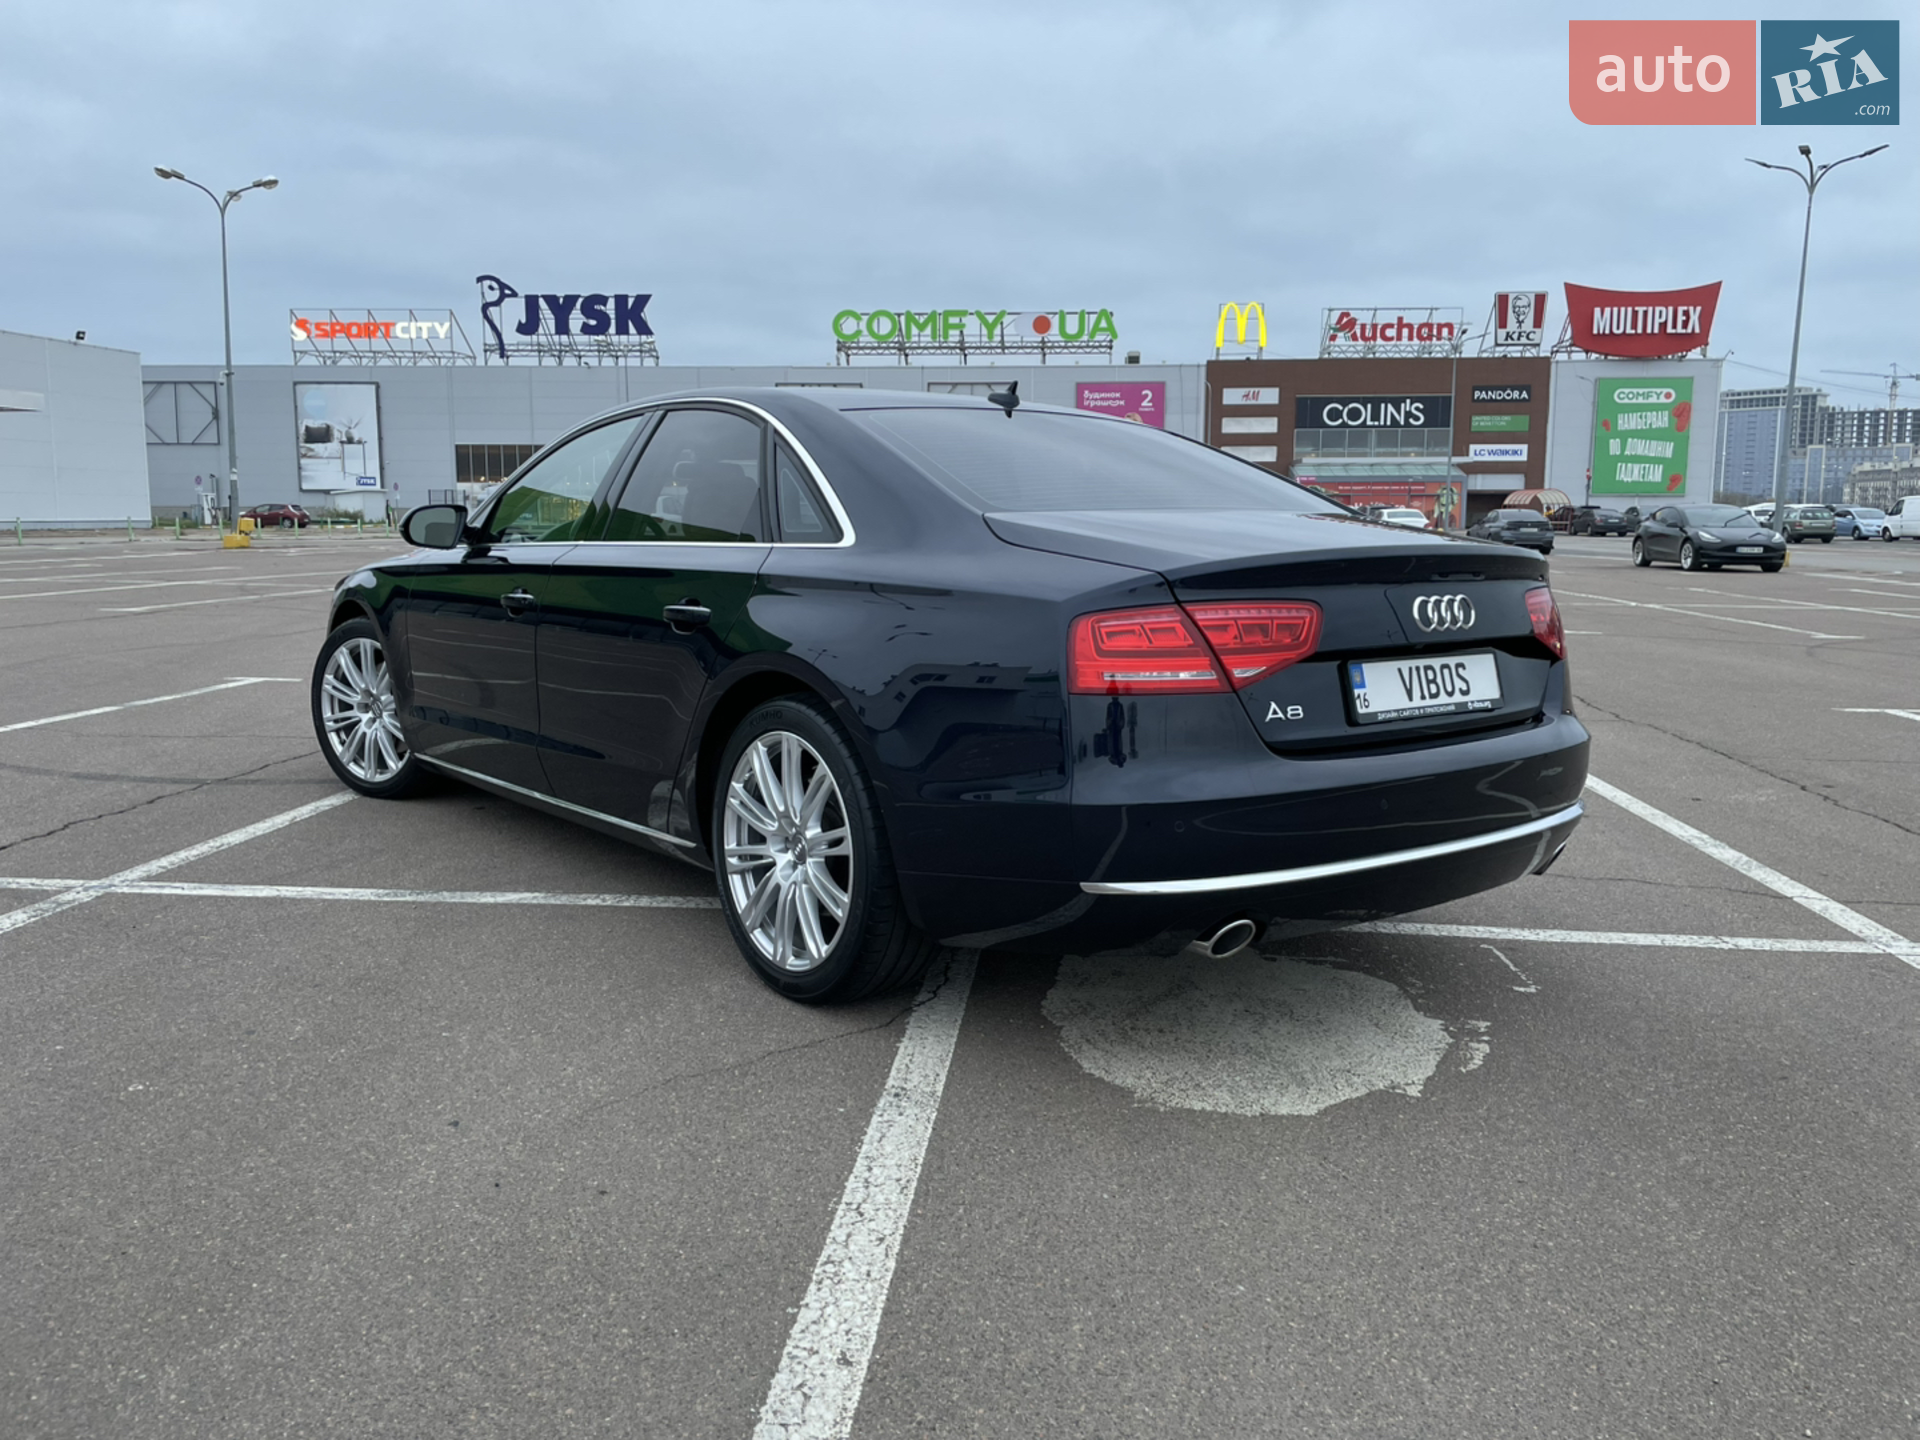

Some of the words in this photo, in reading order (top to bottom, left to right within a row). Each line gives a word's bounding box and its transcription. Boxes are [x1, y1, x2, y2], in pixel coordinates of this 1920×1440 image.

[515, 294, 654, 336] JYSK
[1592, 305, 1702, 335] MULTIPLEX
[314, 321, 450, 340] SPORTCITY
[832, 309, 1008, 342] COMFY
[1058, 308, 1119, 341] UA
[1328, 311, 1454, 343] Auchan
[1503, 330, 1536, 342] KFC
[1140, 389, 1153, 407] 2
[1474, 388, 1529, 400] PANDORA
[1617, 391, 1664, 400] COMFY
[1322, 399, 1425, 426] COLIN'S
[1617, 411, 1669, 430] НАМБЕРВАН
[1474, 449, 1485, 457] LC
[1609, 438, 1621, 455] ПО
[1624, 438, 1674, 458] ДОМАШНІМ
[1616, 462, 1664, 482] ГАДЖЕТАМ
[1397, 661, 1471, 702] VIBOS
[1356, 692, 1370, 709] 16
[750, 710, 783, 728] KUMHO
[1265, 700, 1304, 722] A8
